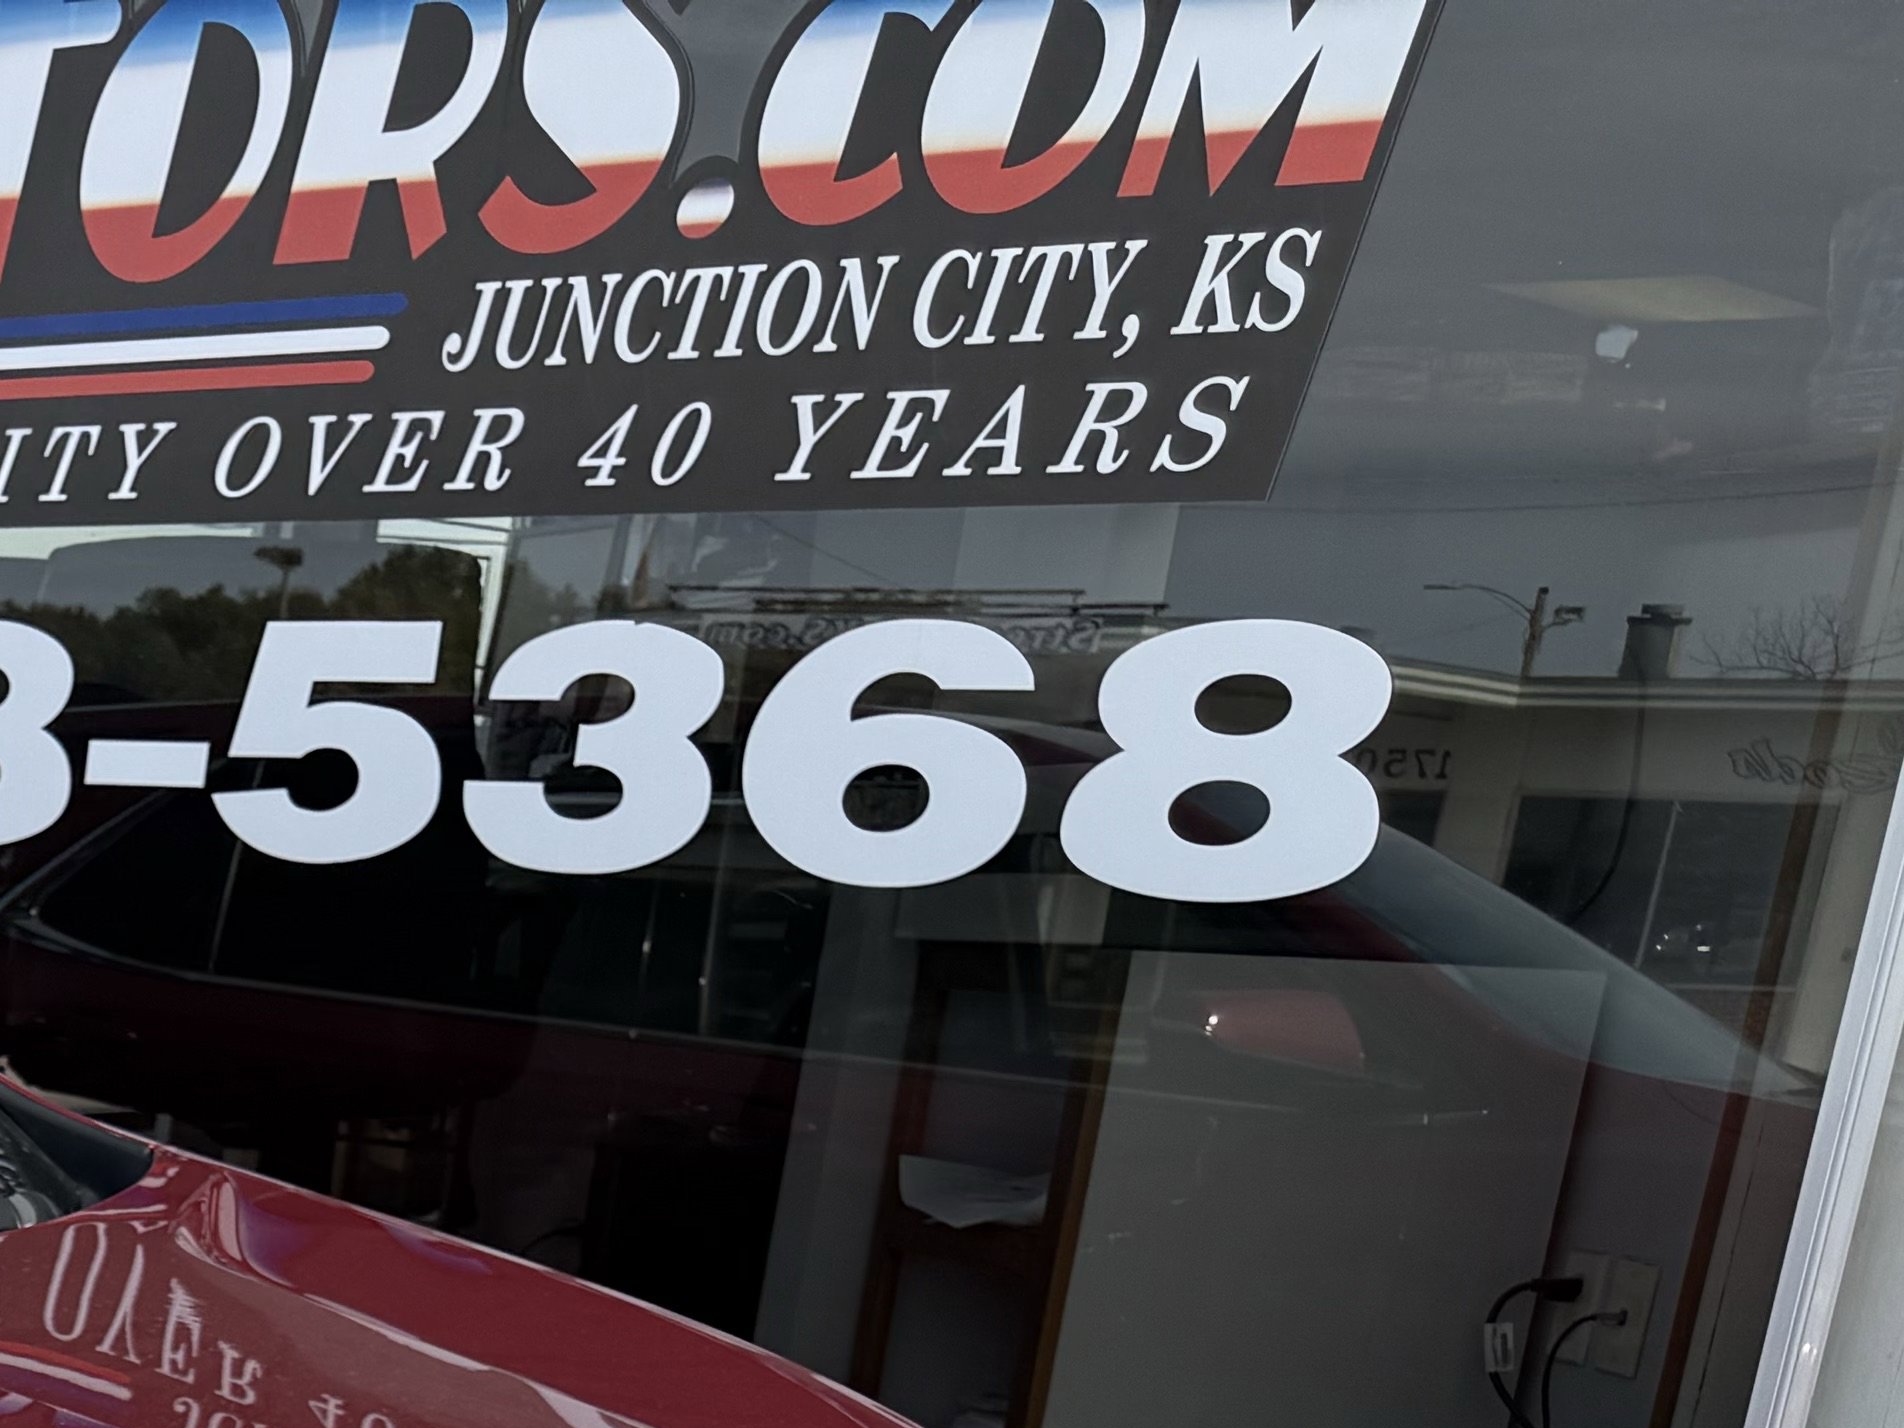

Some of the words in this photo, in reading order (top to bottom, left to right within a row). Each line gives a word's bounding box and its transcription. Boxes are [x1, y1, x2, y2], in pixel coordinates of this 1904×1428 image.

[440, 253, 901, 374] JUNCTION
[911, 238, 1150, 360] CITY,
[1168, 226, 1324, 336] KS
[213, 400, 526, 500] OVER
[576, 401, 713, 488] 40
[773, 375, 1252, 483] YEARS
